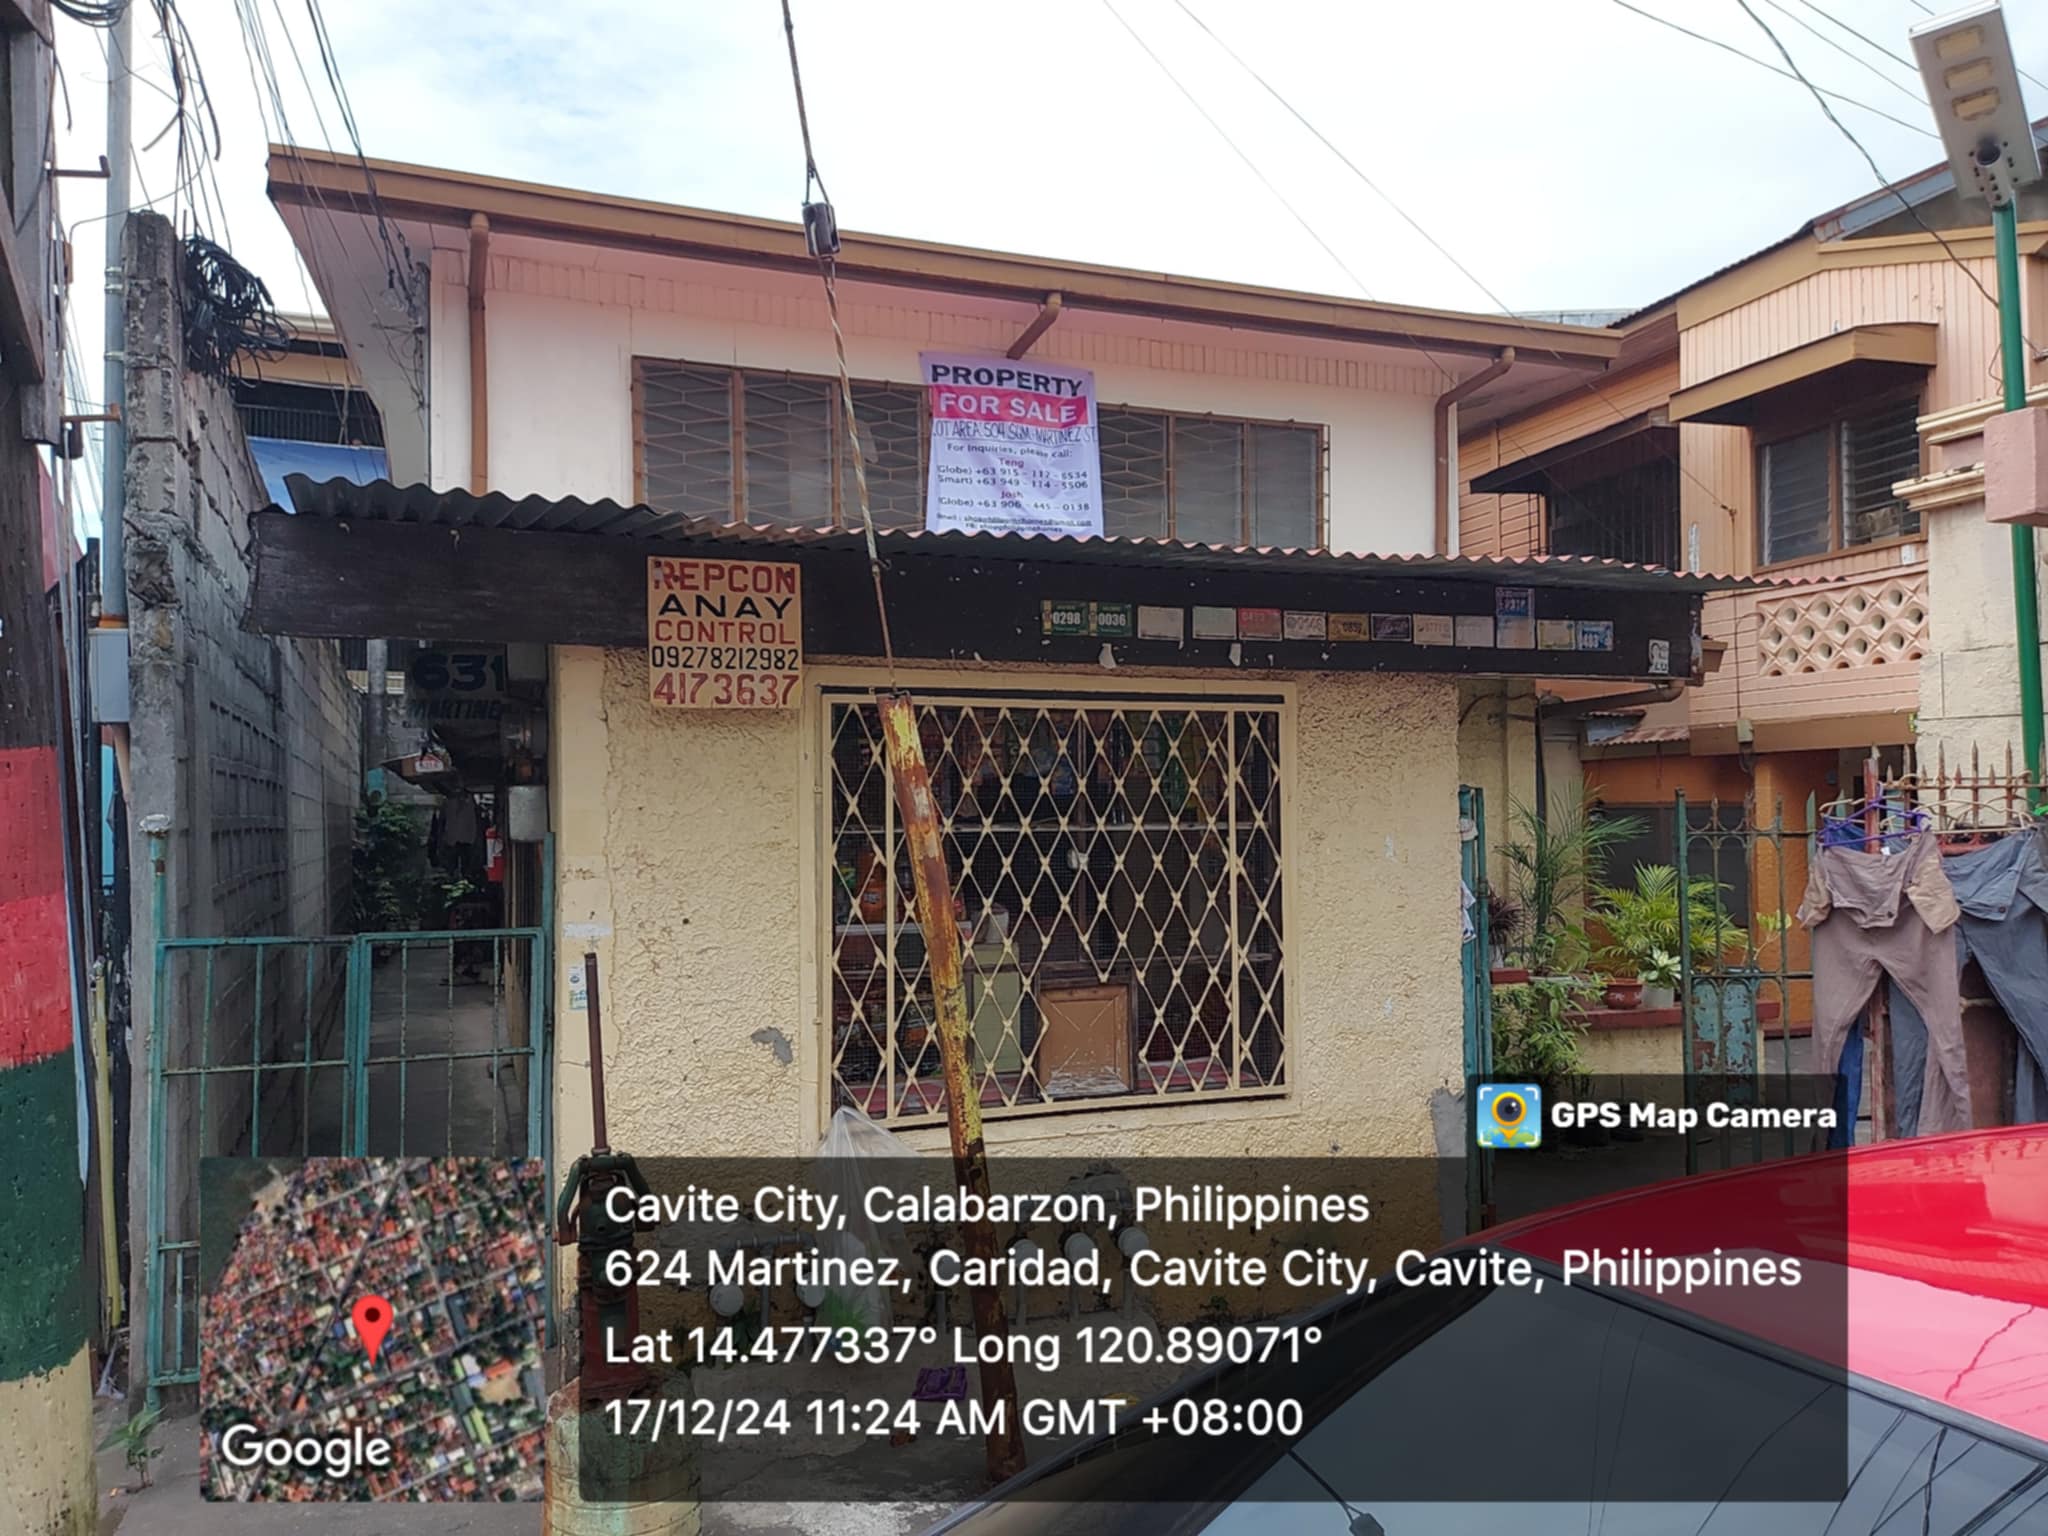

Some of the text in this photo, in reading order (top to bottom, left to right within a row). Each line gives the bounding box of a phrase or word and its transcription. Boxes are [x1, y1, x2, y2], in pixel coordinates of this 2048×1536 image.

[931, 363, 1083, 397] PROPERTY
[940, 392, 1077, 423] FOR SALE
[933, 420, 951, 437] OT
[947, 442, 964, 452] For
[976, 466, 997, 476] +63
[999, 456, 1025, 469] Teng
[976, 476, 997, 486] +63
[653, 559, 796, 595] REPCON
[658, 593, 793, 620] ANAY
[1052, 612, 1081, 625] 0298
[655, 620, 796, 645] CONTROL
[652, 646, 799, 671] 09278212982
[415, 654, 504, 691] 631
[653, 672, 799, 705] 417 3637
